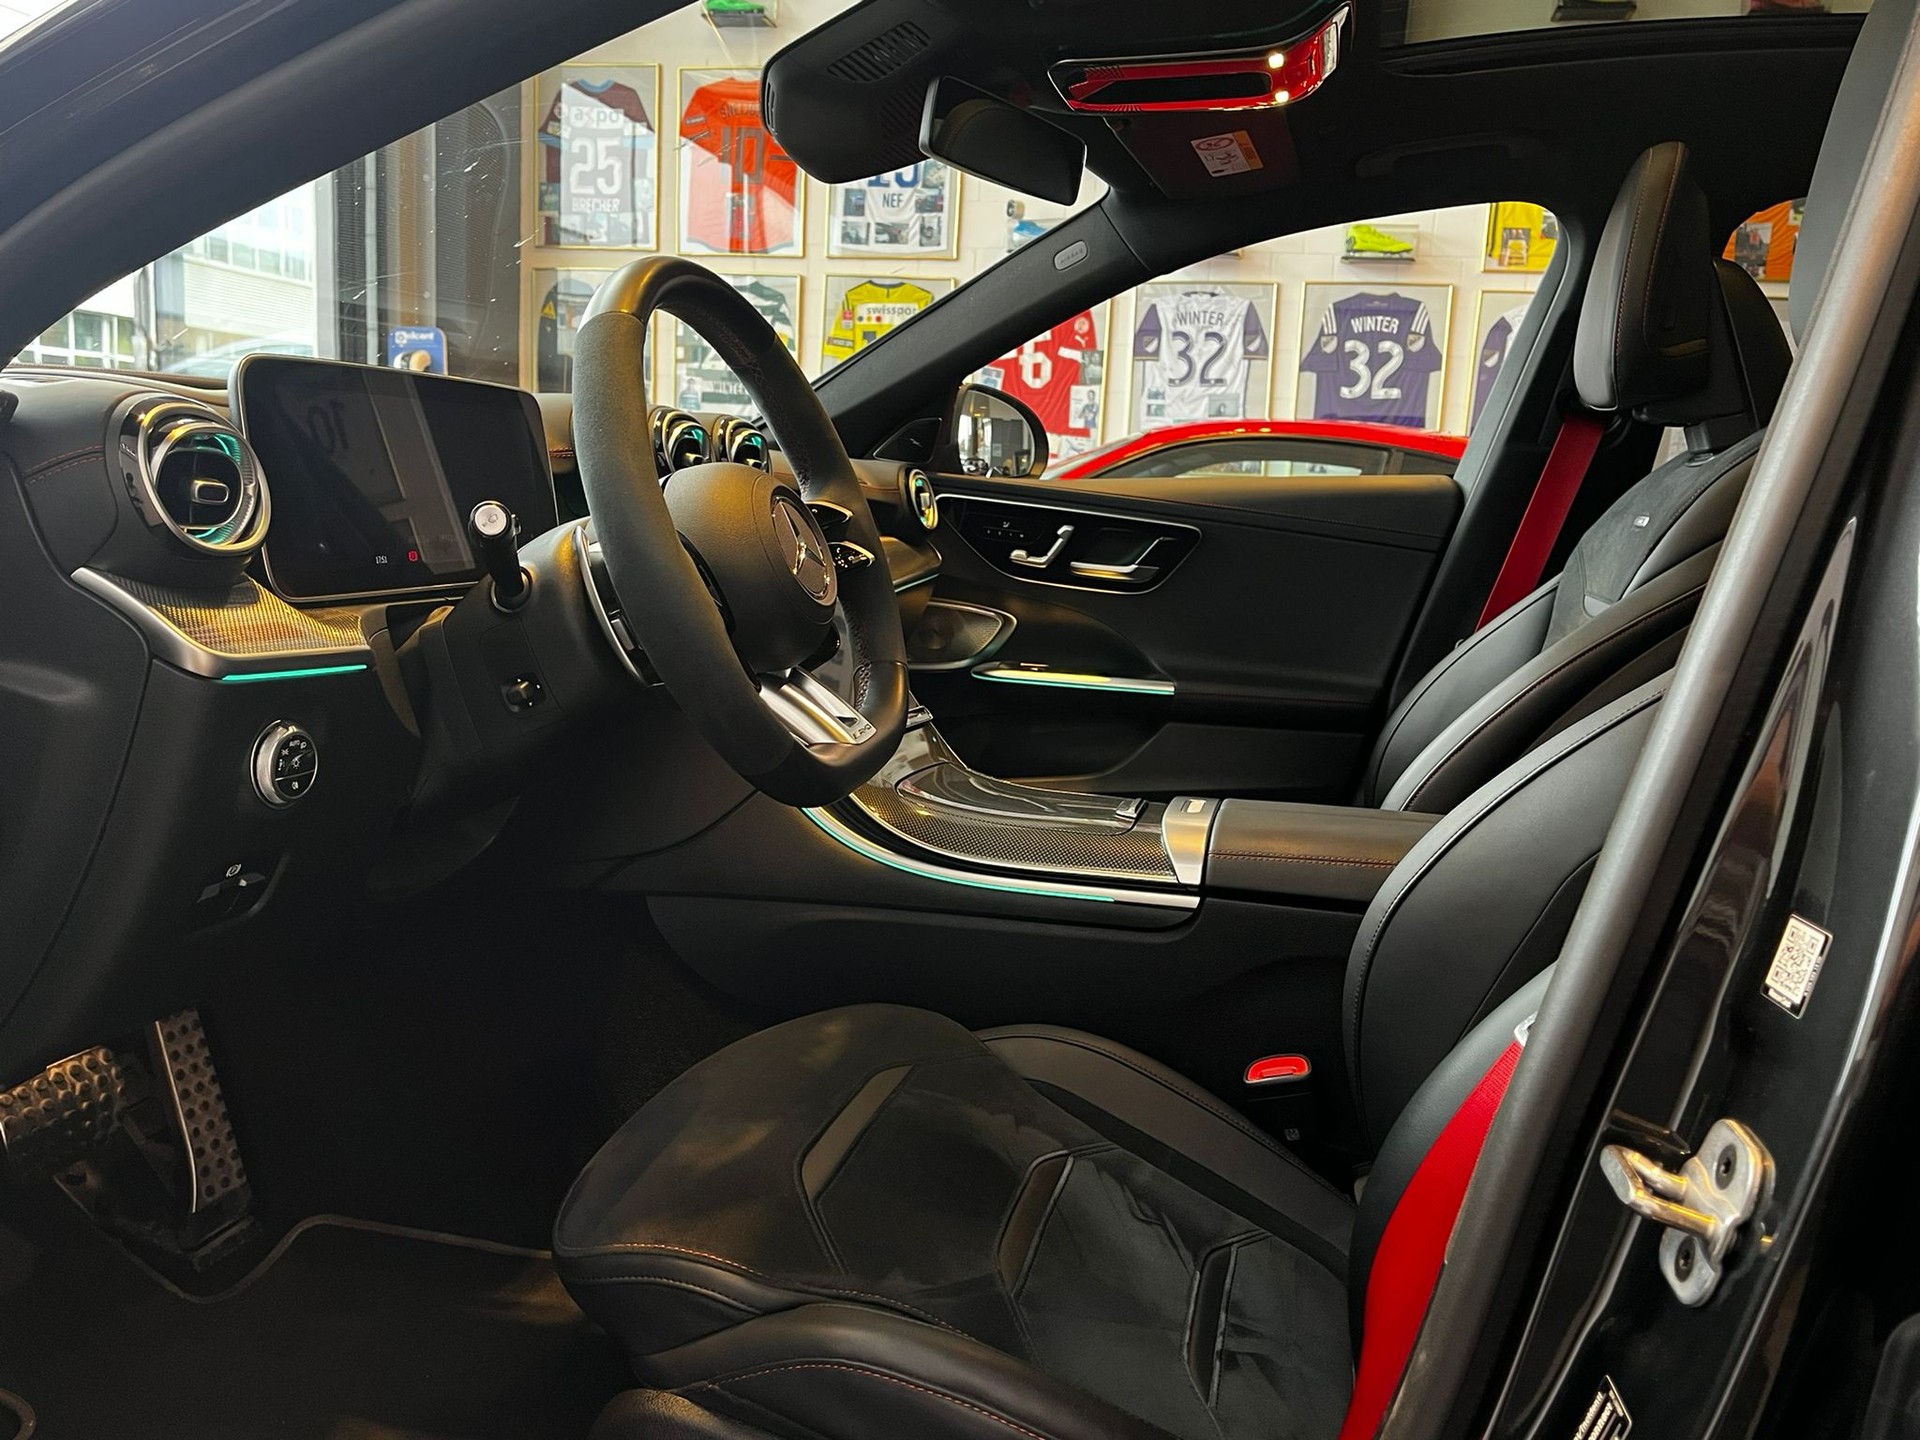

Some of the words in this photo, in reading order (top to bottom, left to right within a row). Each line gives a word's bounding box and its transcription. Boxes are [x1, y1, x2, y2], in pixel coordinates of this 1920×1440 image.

[569, 137, 622, 195] 25
[882, 192, 904, 209] NEF
[1175, 310, 1225, 327] WINTER
[1351, 315, 1400, 334] WINTER
[1168, 331, 1227, 388] 32
[1340, 339, 1404, 400] 32
